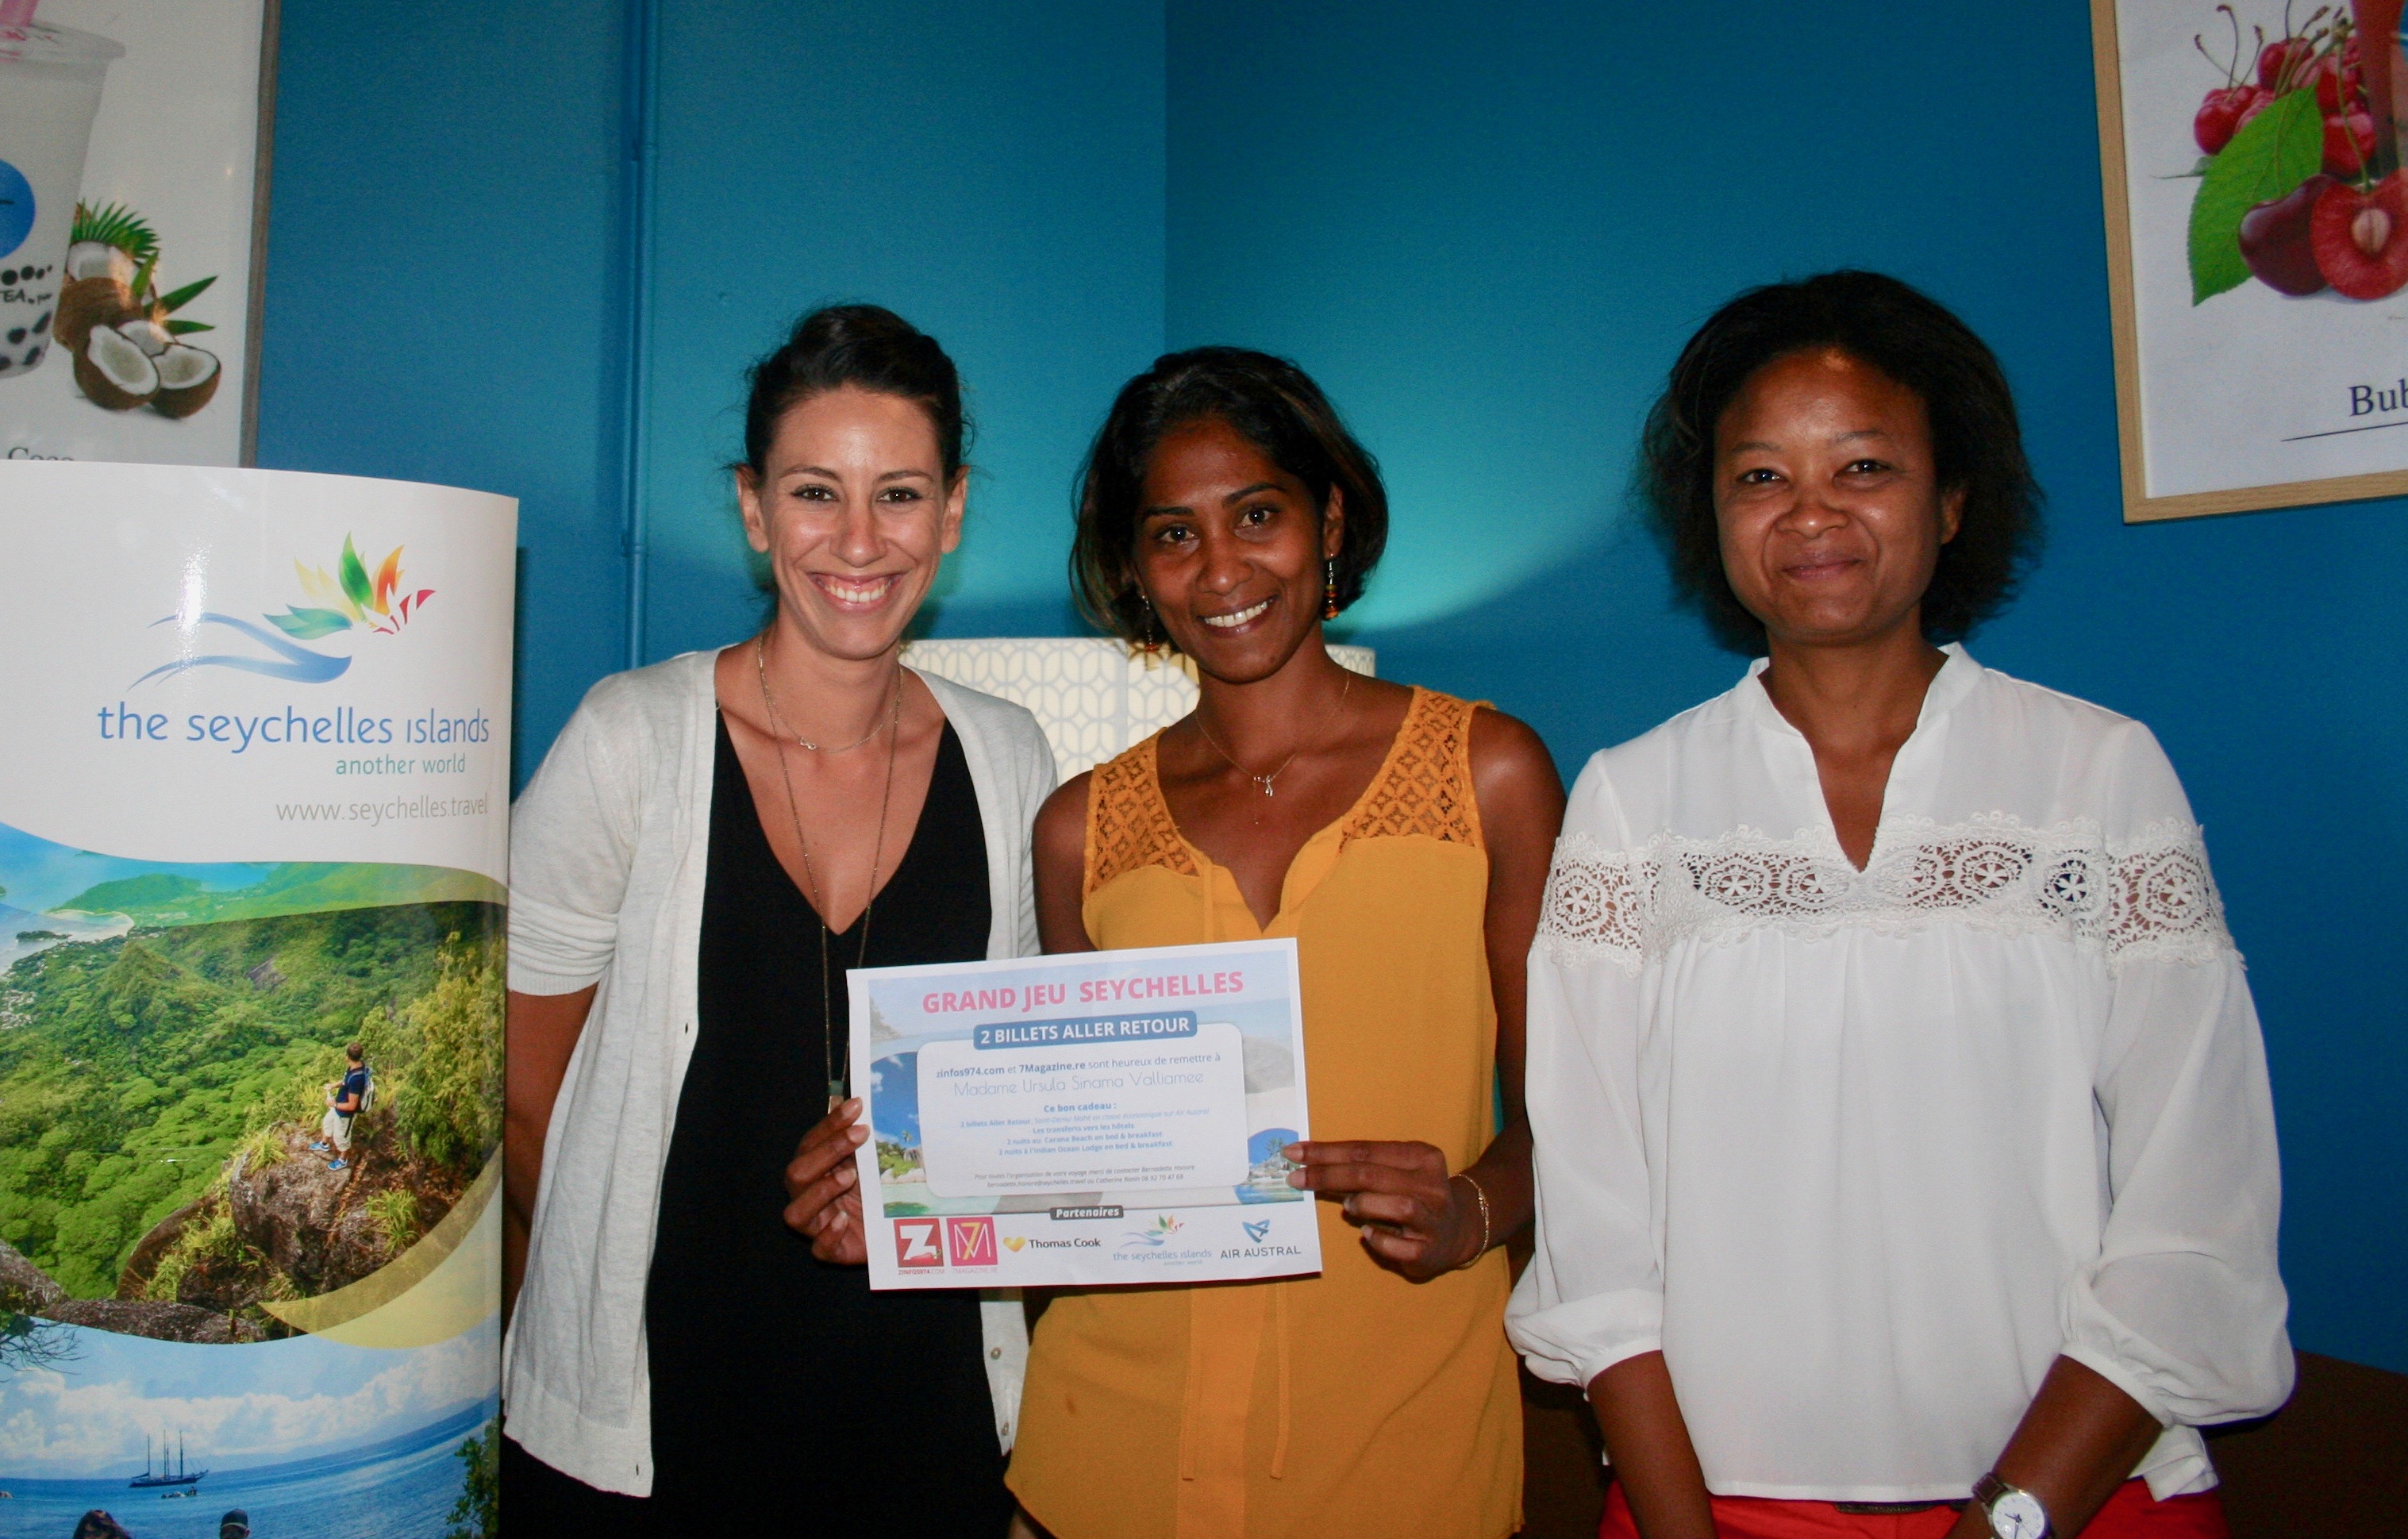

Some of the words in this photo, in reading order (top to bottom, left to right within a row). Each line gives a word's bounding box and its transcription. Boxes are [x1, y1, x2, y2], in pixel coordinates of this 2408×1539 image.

[97, 701, 168, 740] the
[187, 706, 393, 753] seychelles
[336, 754, 415, 775] another
[422, 752, 466, 773] world
[275, 792, 489, 826] www.seychelles.travel
[922, 987, 1016, 1014] GRAND
[1021, 983, 1066, 1012] JEU
[1079, 971, 1244, 1002] SEYCHELLES
[980, 1031, 991, 1045] 2
[994, 1025, 1059, 1044] BILLETS
[1062, 1022, 1115, 1039] ALLER
[1120, 1017, 1190, 1035] RETOUR
[936, 1066, 1005, 1079] zinfos974.com
[1007, 1065, 1017, 1075] et
[1018, 1062, 1086, 1074] 7Magazine.re
[1088, 1060, 1110, 1069] sont
[1112, 1058, 1152, 1068] heureux
[1154, 1056, 1167, 1065] de
[1169, 1053, 1213, 1064] remettre
[1215, 1052, 1221, 1062] à
[954, 1081, 1017, 1097] Madame
[1022, 1077, 1066, 1094] Ursula
[1071, 1075, 1124, 1091] Sinama
[1129, 1072, 1204, 1087] Valliamee
[1043, 1104, 1056, 1113] Ce
[1057, 1103, 1075, 1112] bon
[1077, 1102, 1112, 1111] cadeau
[1056, 1206, 1120, 1219] Partenaires
[1029, 1239, 1071, 1249] Thomas
[1074, 1238, 1102, 1249] Cook
[1220, 1249, 1241, 1260] AIR
[1244, 1245, 1302, 1257] AUSTRAL
[1113, 1252, 1129, 1261] the
[1131, 1250, 1178, 1262] seychelles
